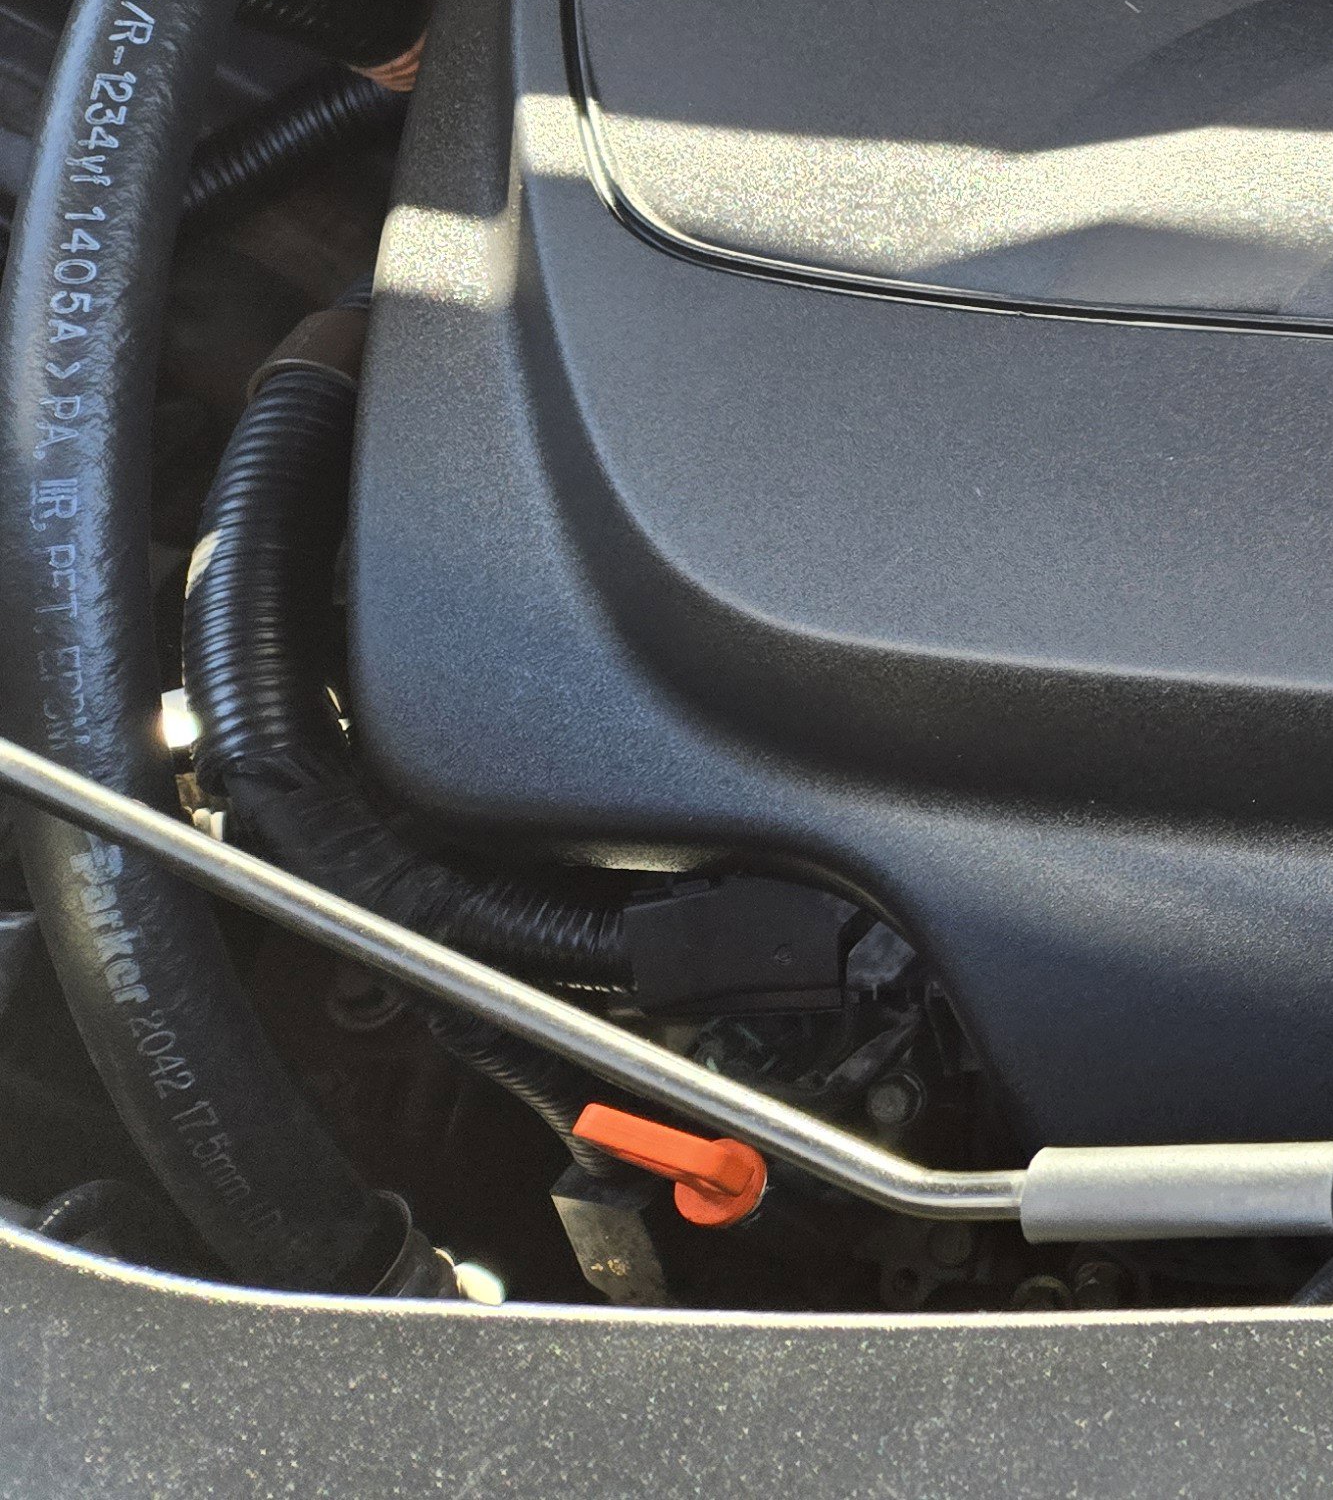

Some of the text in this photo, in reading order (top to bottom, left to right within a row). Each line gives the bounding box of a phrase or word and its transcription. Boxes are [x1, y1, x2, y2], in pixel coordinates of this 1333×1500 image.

[48, 205, 107, 344] 1405A
[69, 842, 151, 1004] Parker
[127, 1009, 196, 1100] 2042
